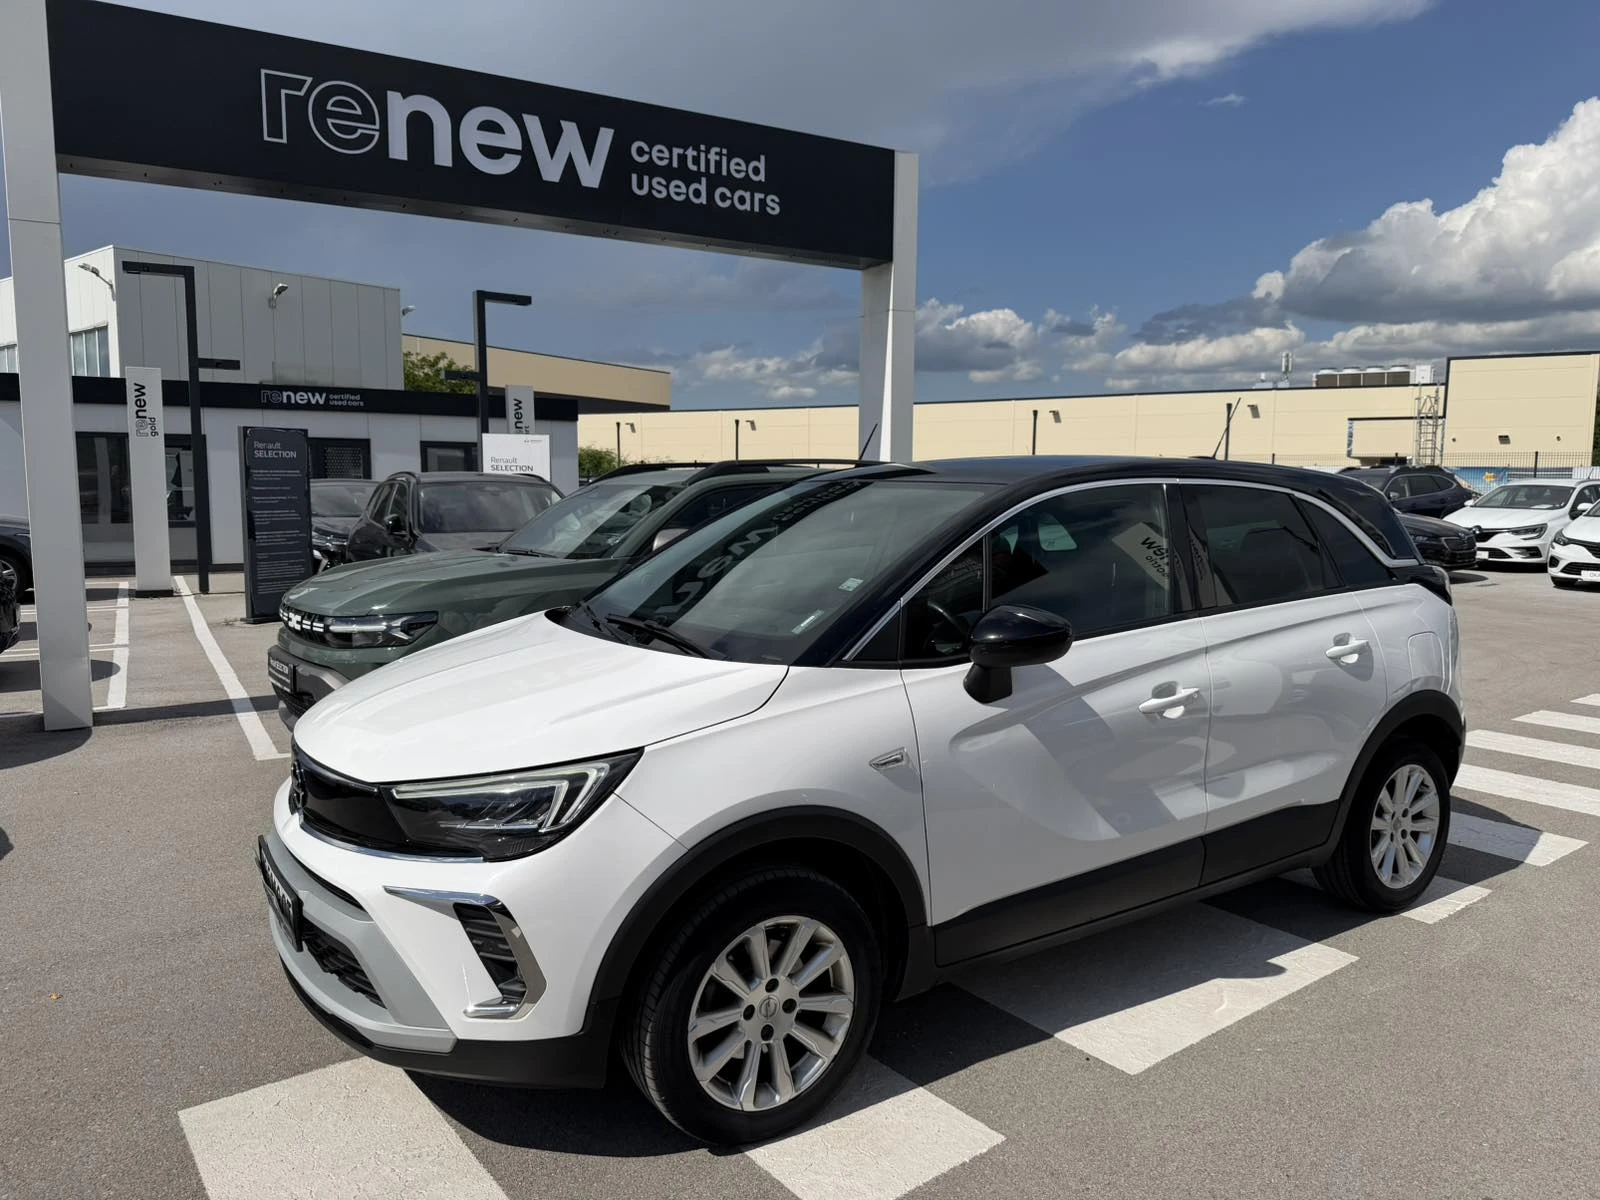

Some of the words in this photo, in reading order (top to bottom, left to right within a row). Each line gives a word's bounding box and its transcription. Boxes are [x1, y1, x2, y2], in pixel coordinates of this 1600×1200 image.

[260, 68, 615, 189] renew
[630, 140, 766, 183] certified
[630, 173, 708, 205] used
[713, 185, 781, 216] cars
[261, 390, 327, 405] renew
[328, 392, 361, 401] certified
[133, 382, 149, 438] renew
[147, 416, 159, 437] gold
[253, 440, 281, 450] Renault
[253, 449, 297, 459] SELECTION
[490, 456, 518, 464] Renault
[490, 464, 534, 472] SELECTION
